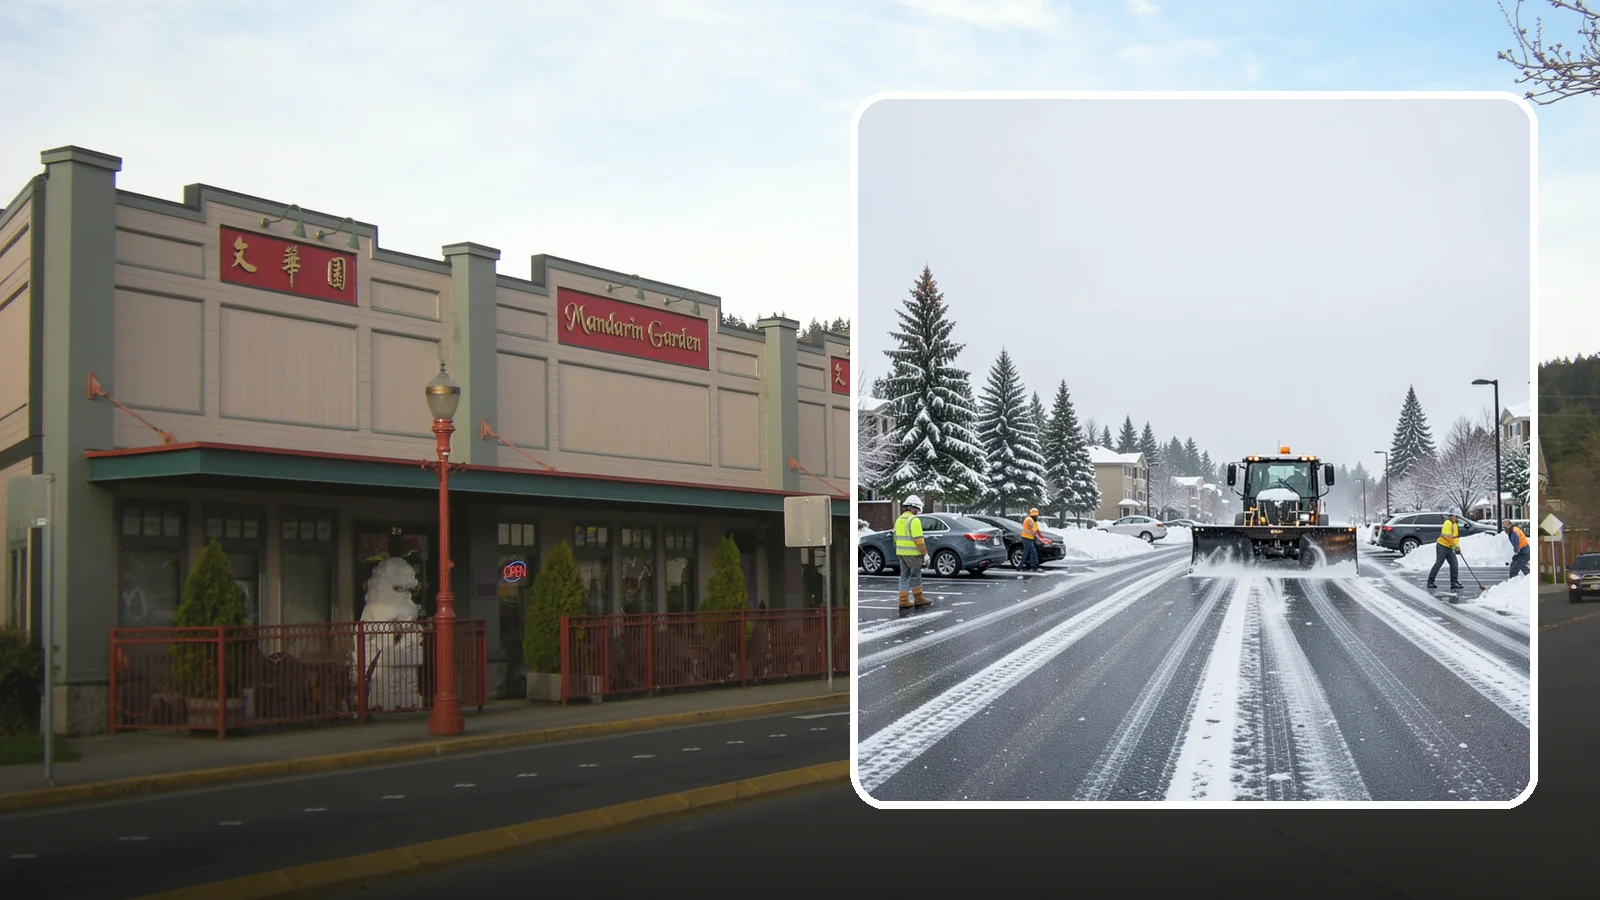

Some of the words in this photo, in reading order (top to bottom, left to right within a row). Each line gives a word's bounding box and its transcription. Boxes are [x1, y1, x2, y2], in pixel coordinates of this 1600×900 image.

[231, 236, 346, 291] 文華園
[565, 302, 644, 340] Mandarin
[648, 320, 702, 352] Garden
[503, 565, 527, 578] OPEN
